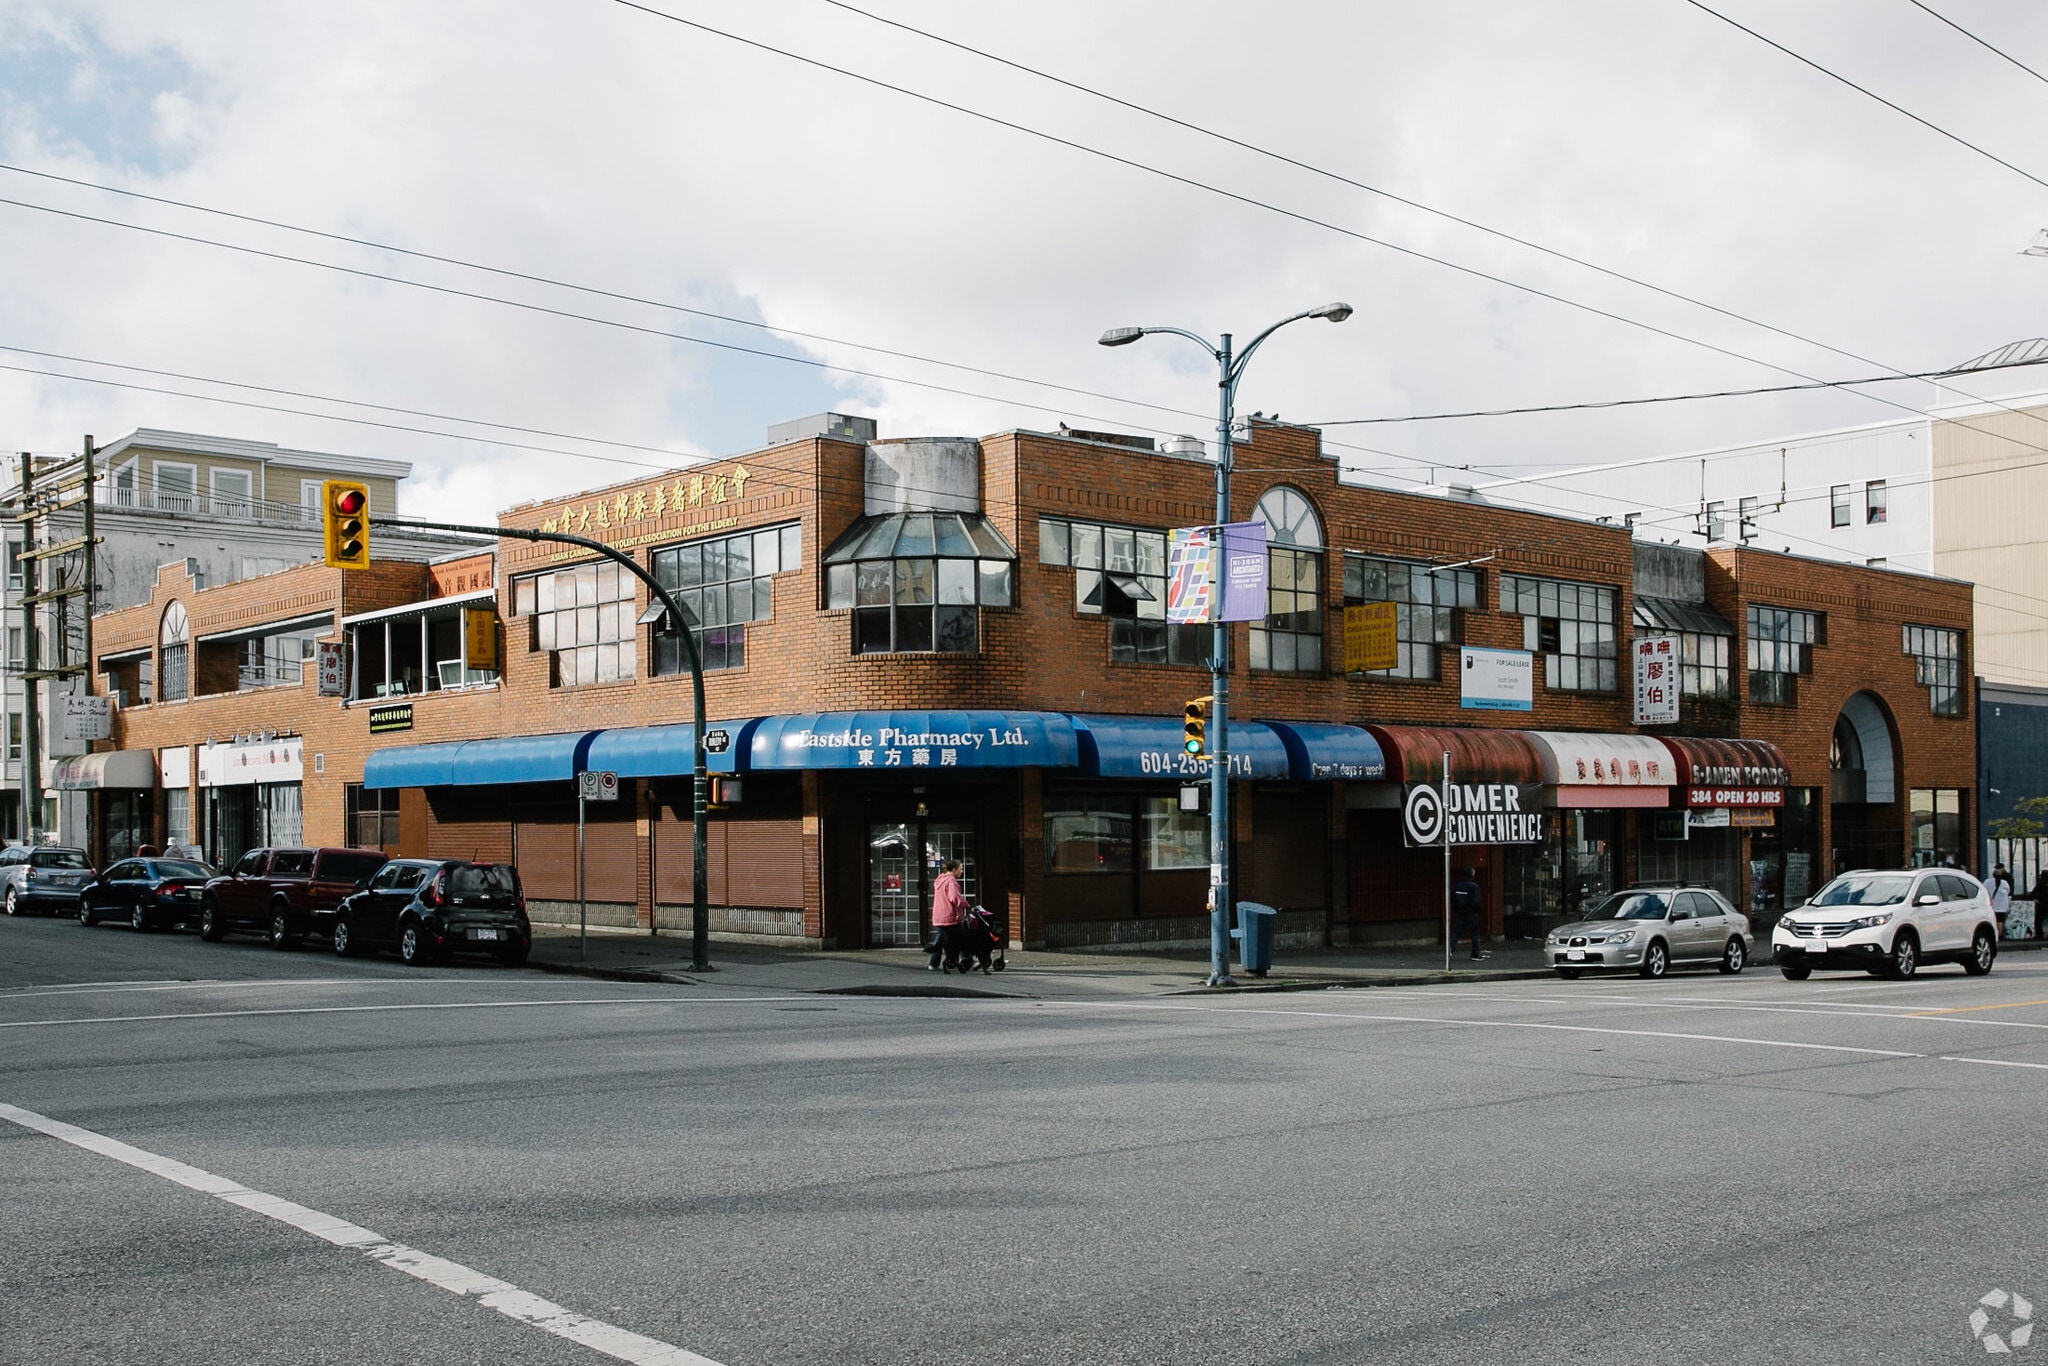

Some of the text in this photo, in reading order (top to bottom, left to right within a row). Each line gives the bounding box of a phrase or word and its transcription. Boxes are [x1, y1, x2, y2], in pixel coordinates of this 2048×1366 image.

[551, 551, 568, 562] ASIAN
[640, 529, 682, 545] ASSOCIATION
[683, 526, 697, 536] FOR
[698, 523, 710, 534] THE
[711, 516, 739, 531] ELDERLY
[1496, 658, 1505, 666] FOR
[799, 727, 1029, 750] Eastside Pharmacy Ltd.
[858, 748, 958, 766] 東方藥房
[1141, 751, 1252, 775] 604-255-714
[1340, 763, 1357, 778] days
[1365, 763, 1384, 776] week
[1691, 790, 1781, 804] 384 OPEN 20 HRS
[1449, 813, 1542, 843] CONVENIENCE
